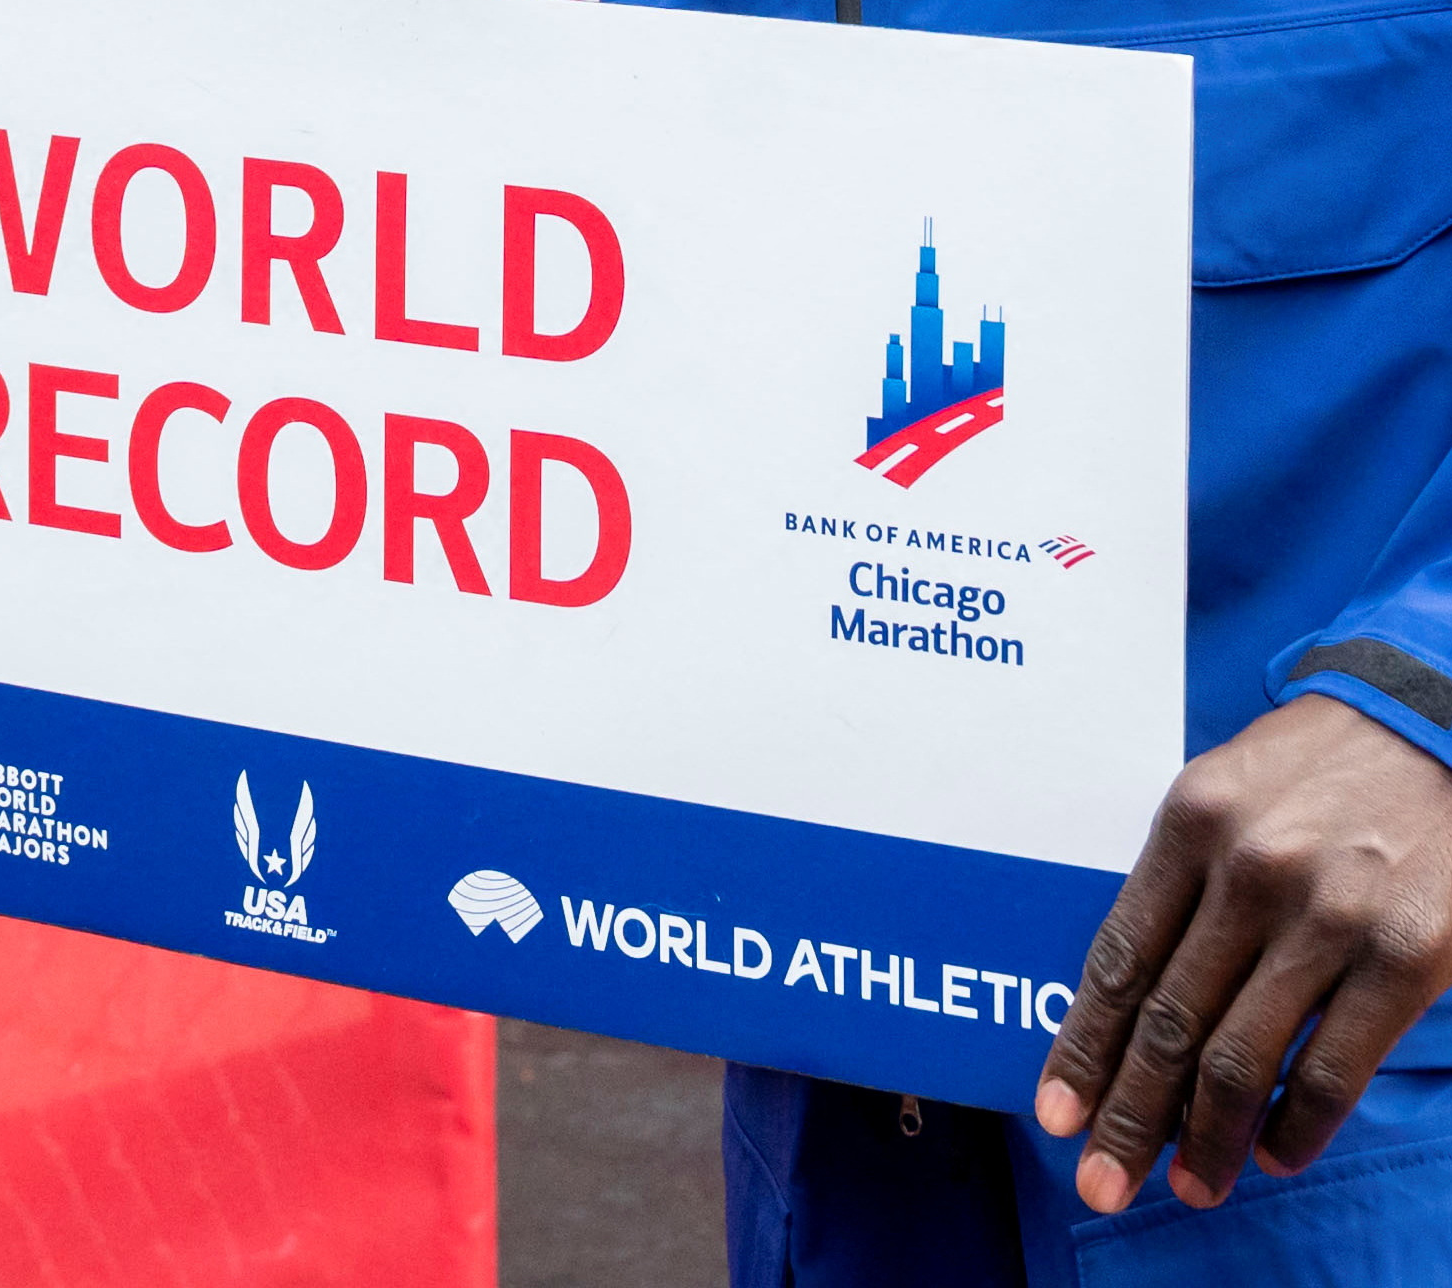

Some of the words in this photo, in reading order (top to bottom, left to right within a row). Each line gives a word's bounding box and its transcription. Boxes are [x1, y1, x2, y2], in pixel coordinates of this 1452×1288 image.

[785, 512, 857, 540] BANK
[865, 523, 899, 545] OF
[905, 528, 1032, 564] AMERICA
[848, 561, 1006, 623] Chicago
[830, 604, 1025, 667] Marathon
[242, 885, 308, 926] USA
[560, 895, 773, 979] WORLD
[782, 937, 1076, 1037] ATHLETIC
